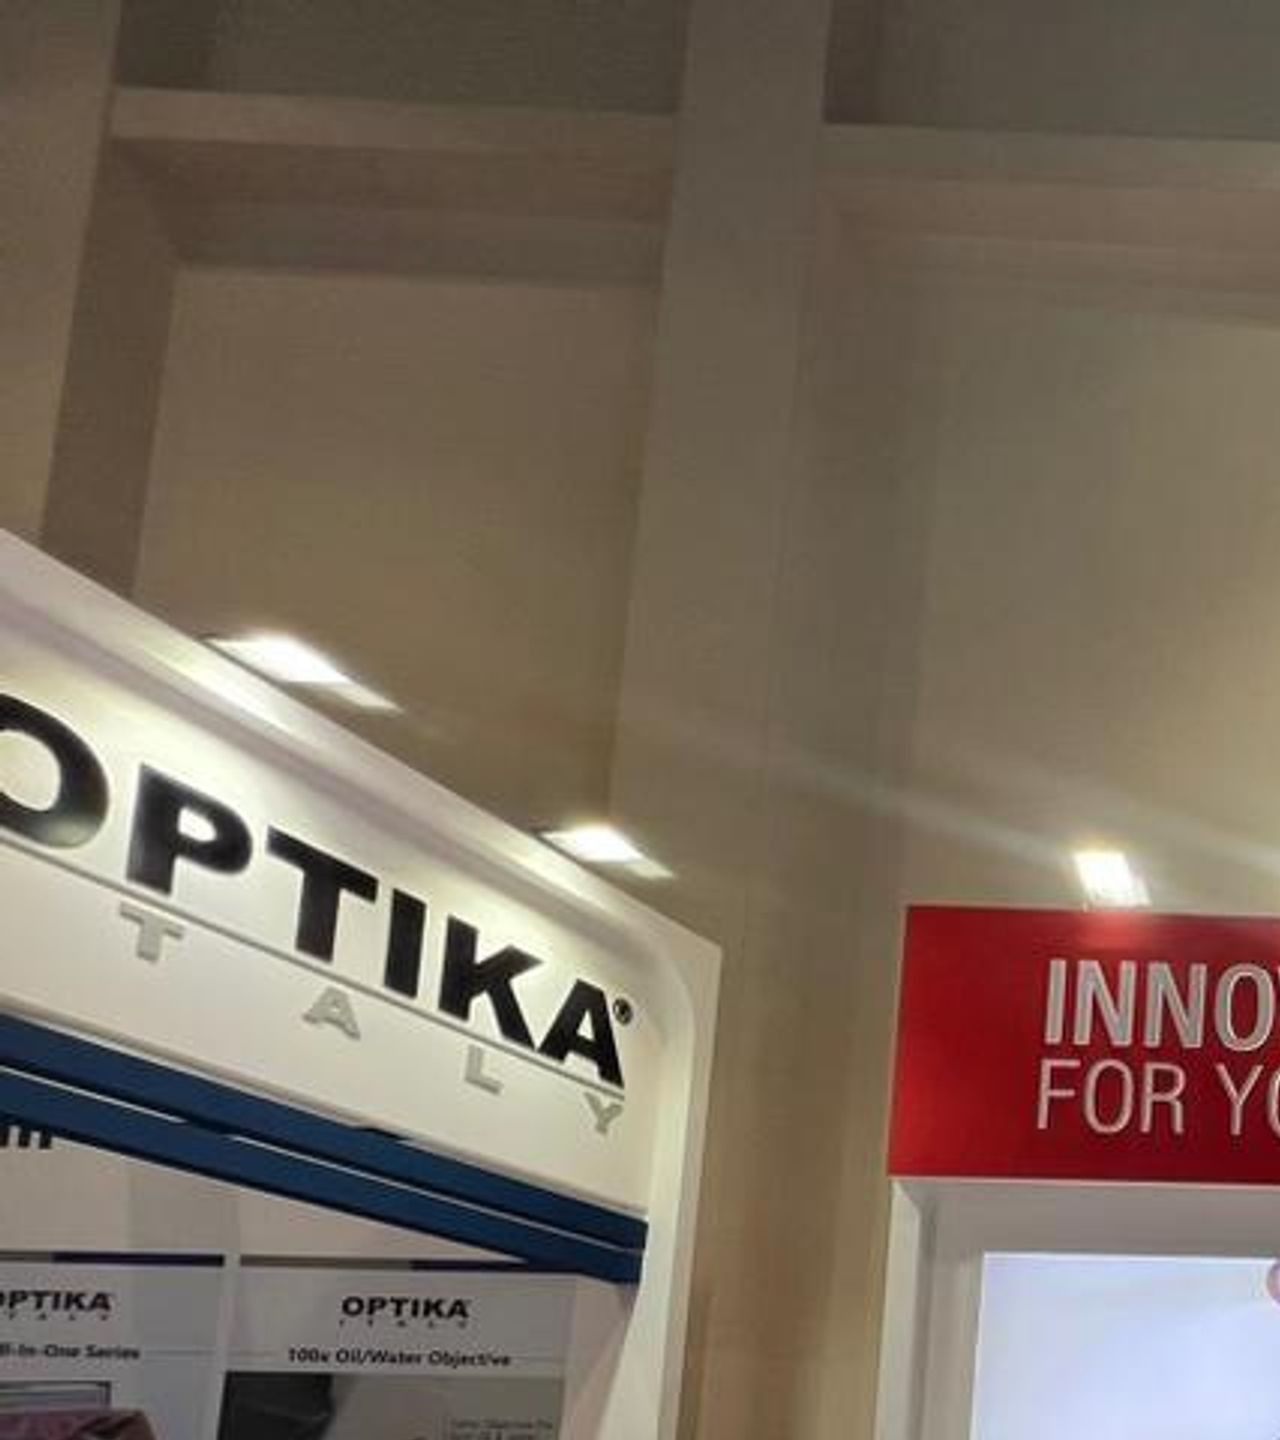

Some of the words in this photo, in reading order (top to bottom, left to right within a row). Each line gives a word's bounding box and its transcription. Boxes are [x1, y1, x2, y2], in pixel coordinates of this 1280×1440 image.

[1036, 1058, 1188, 1135] FOR
[0, 1290, 112, 1312] PTIKA
[342, 1296, 471, 1319] OPTIKA
[335, 1348, 424, 1368] Oil/Water
[428, 1349, 511, 1370] Objective
